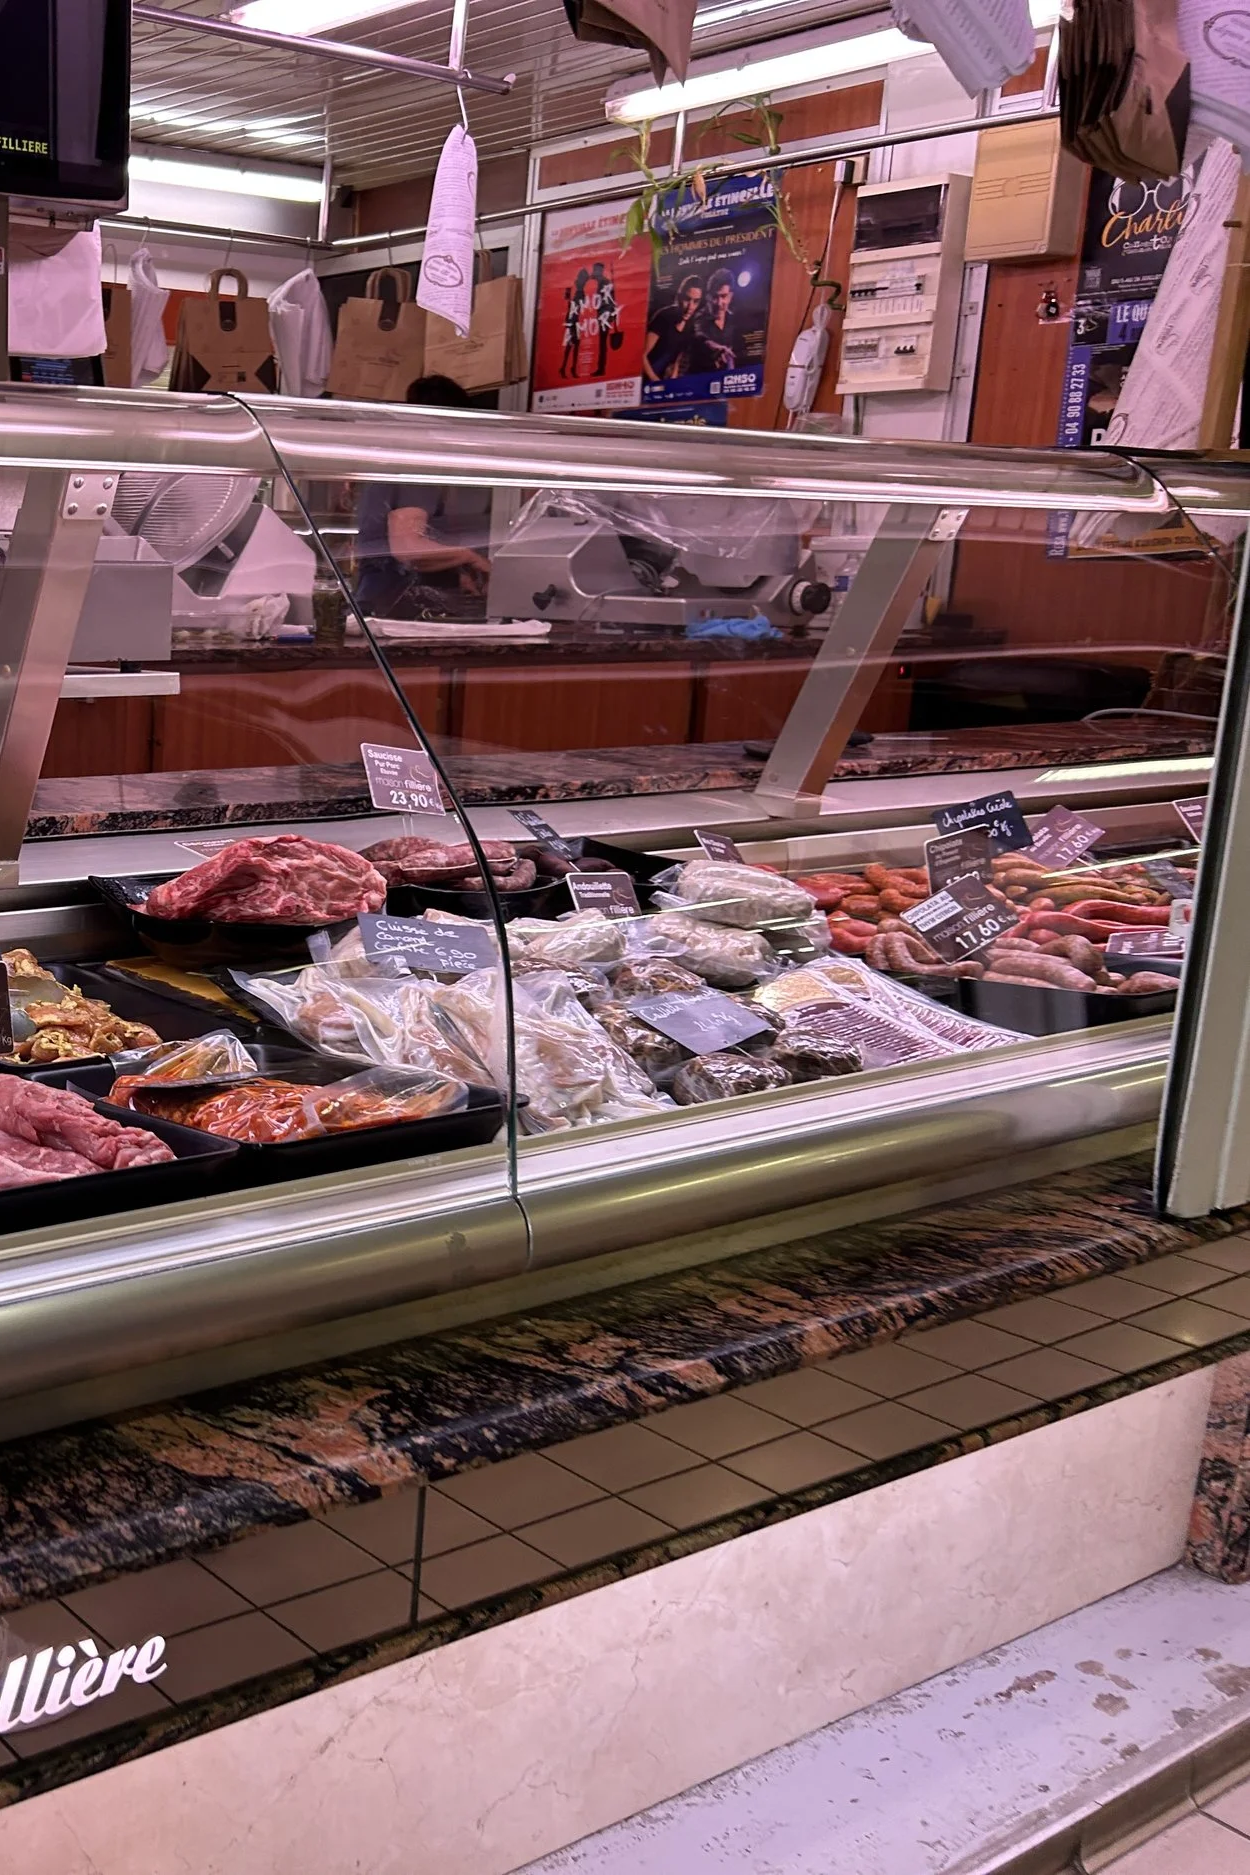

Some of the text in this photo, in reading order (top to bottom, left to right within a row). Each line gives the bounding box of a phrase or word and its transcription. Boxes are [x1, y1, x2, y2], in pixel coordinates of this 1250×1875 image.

[1101, 199, 1184, 247] Charli
[1072, 363, 1087, 376] 33
[1070, 378, 1085, 390] 27
[1067, 405, 1081, 418] 90
[1065, 421, 1079, 435] 04
[367, 749, 403, 762] Saucisse
[390, 790, 428, 810] 23,90
